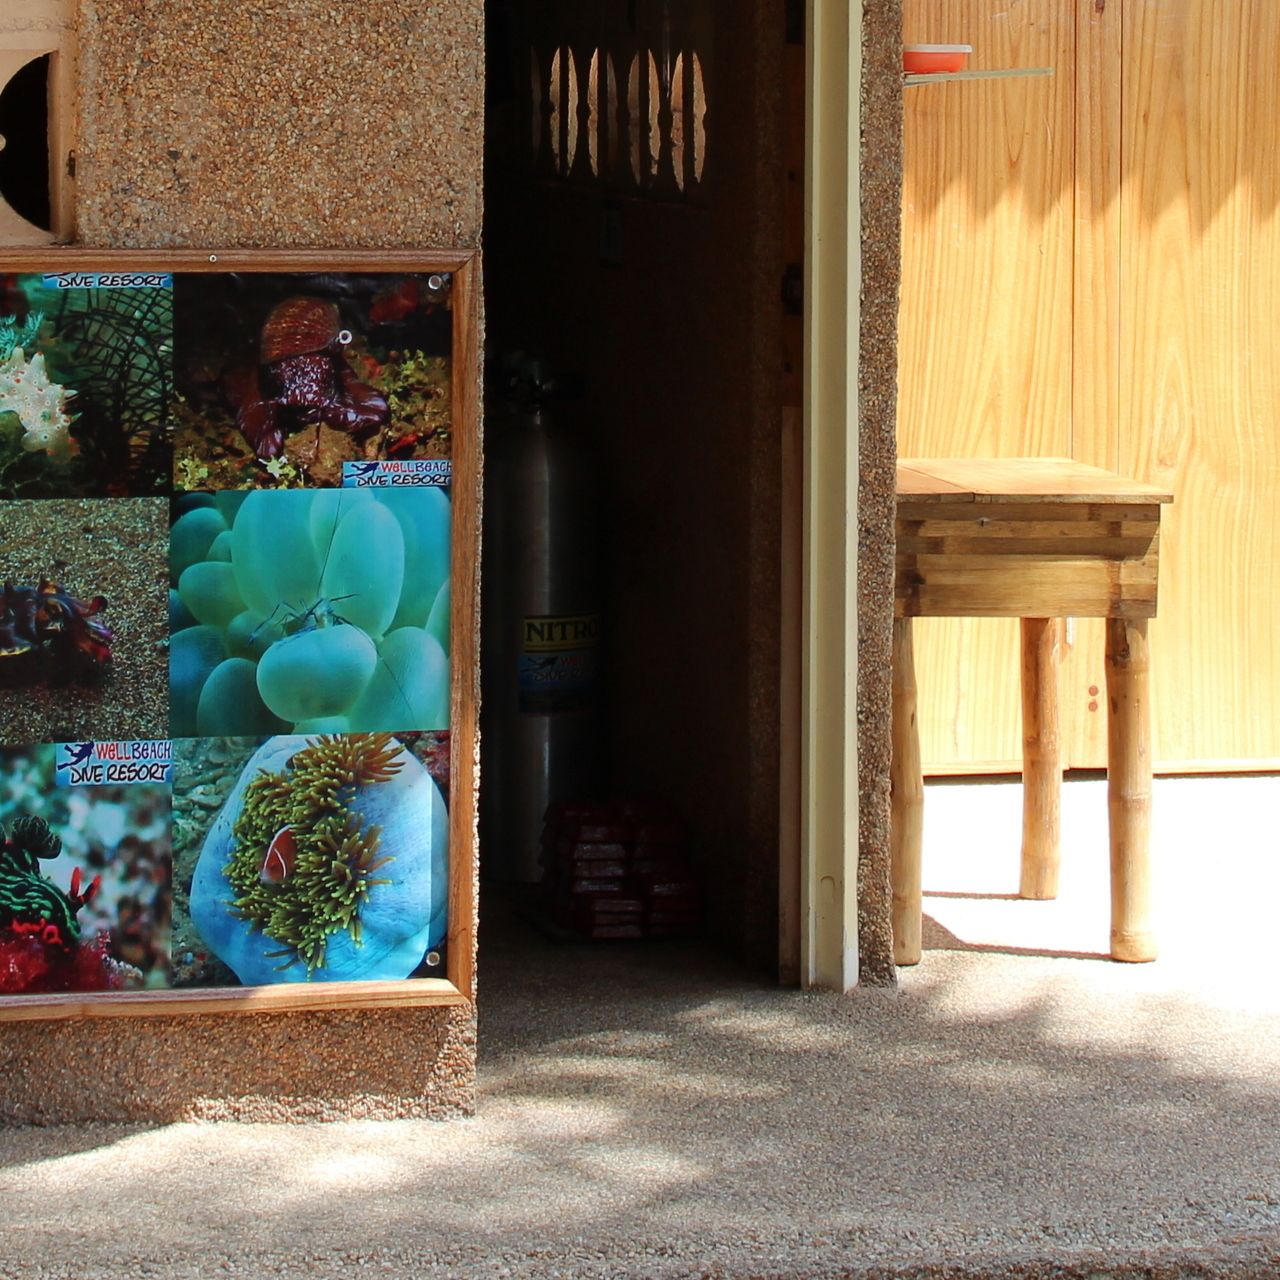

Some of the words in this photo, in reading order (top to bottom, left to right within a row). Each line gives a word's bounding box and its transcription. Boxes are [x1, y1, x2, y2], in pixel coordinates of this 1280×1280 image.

[58, 276, 94, 287] DIVE
[98, 275, 168, 287] RESORT
[357, 475, 388, 486] DIVE
[71, 765, 103, 784] DIVE
[107, 763, 169, 781] RESORT
